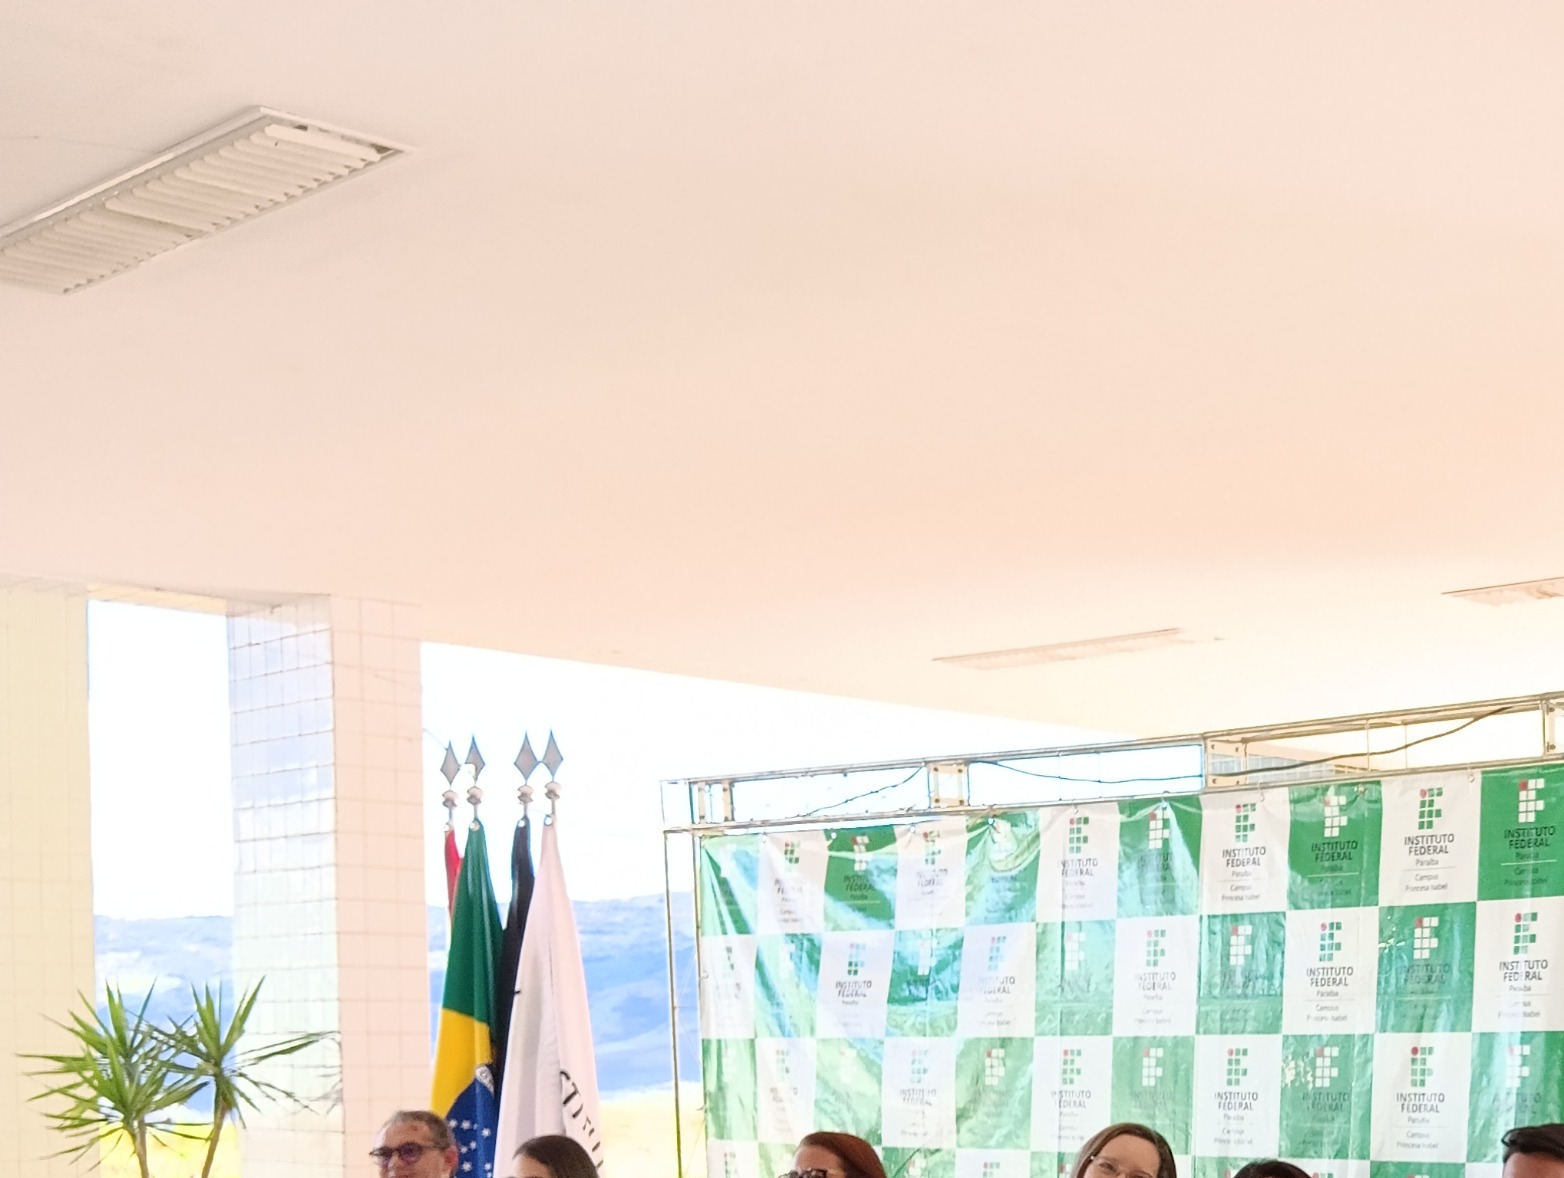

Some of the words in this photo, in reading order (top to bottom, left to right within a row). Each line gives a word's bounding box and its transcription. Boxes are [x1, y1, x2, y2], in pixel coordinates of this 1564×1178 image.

[1404, 833, 1455, 846] INSTITUTO
[1509, 836, 1550, 849] FEDERAL
[1310, 840, 1358, 852] INSTITUTO
[1408, 844, 1450, 856] FEDERAL
[1306, 966, 1354, 976] INSTITUTO
[1311, 976, 1349, 986] FEDERAL
[1396, 1093, 1445, 1102] INSTITUTO
[1218, 1101, 1254, 1110] FEDERAL
[1401, 1103, 1440, 1113] FEDERAL
